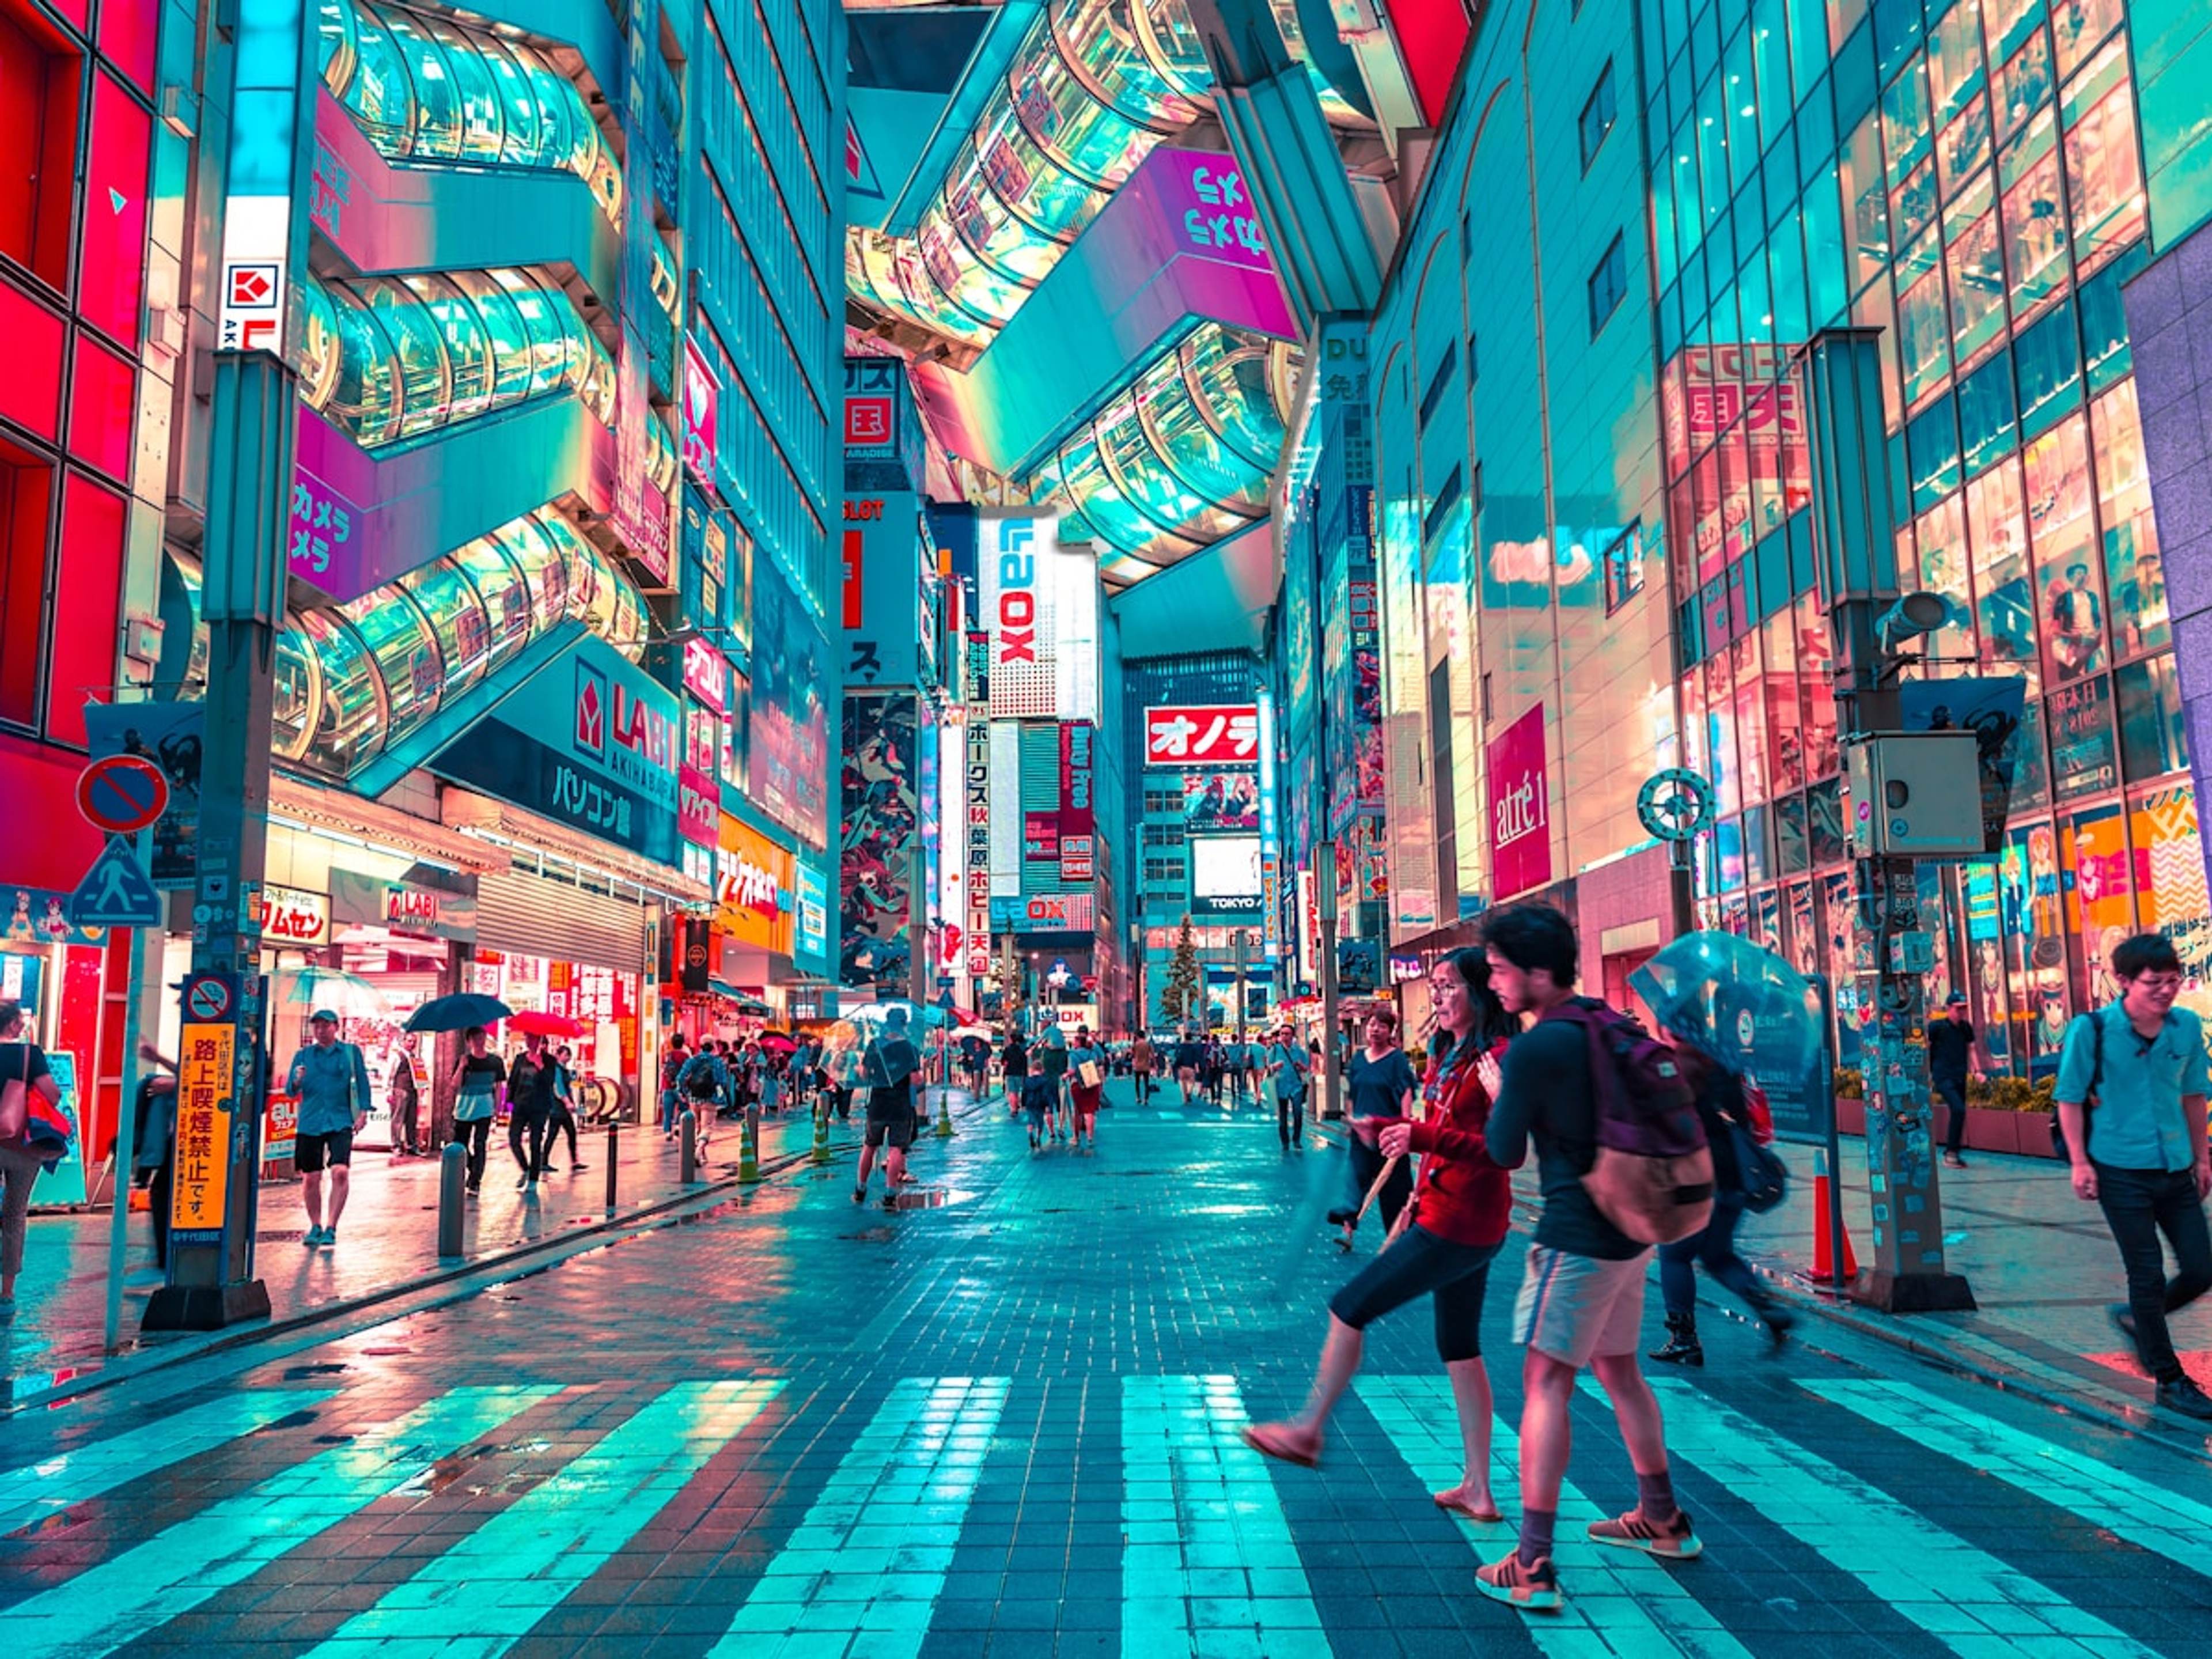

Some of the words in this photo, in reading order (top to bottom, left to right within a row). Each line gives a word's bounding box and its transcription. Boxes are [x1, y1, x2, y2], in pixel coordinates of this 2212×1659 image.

[293, 483, 350, 543] カメラ
[613, 683, 676, 775] LABI
[554, 766, 631, 839] パソコン館
[1497, 768, 1534, 844] atré
[1209, 897, 1254, 908] TOKYO
[187, 1039, 217, 1222] 路上喫煙禁止です。
[271, 1101, 298, 1121] au
